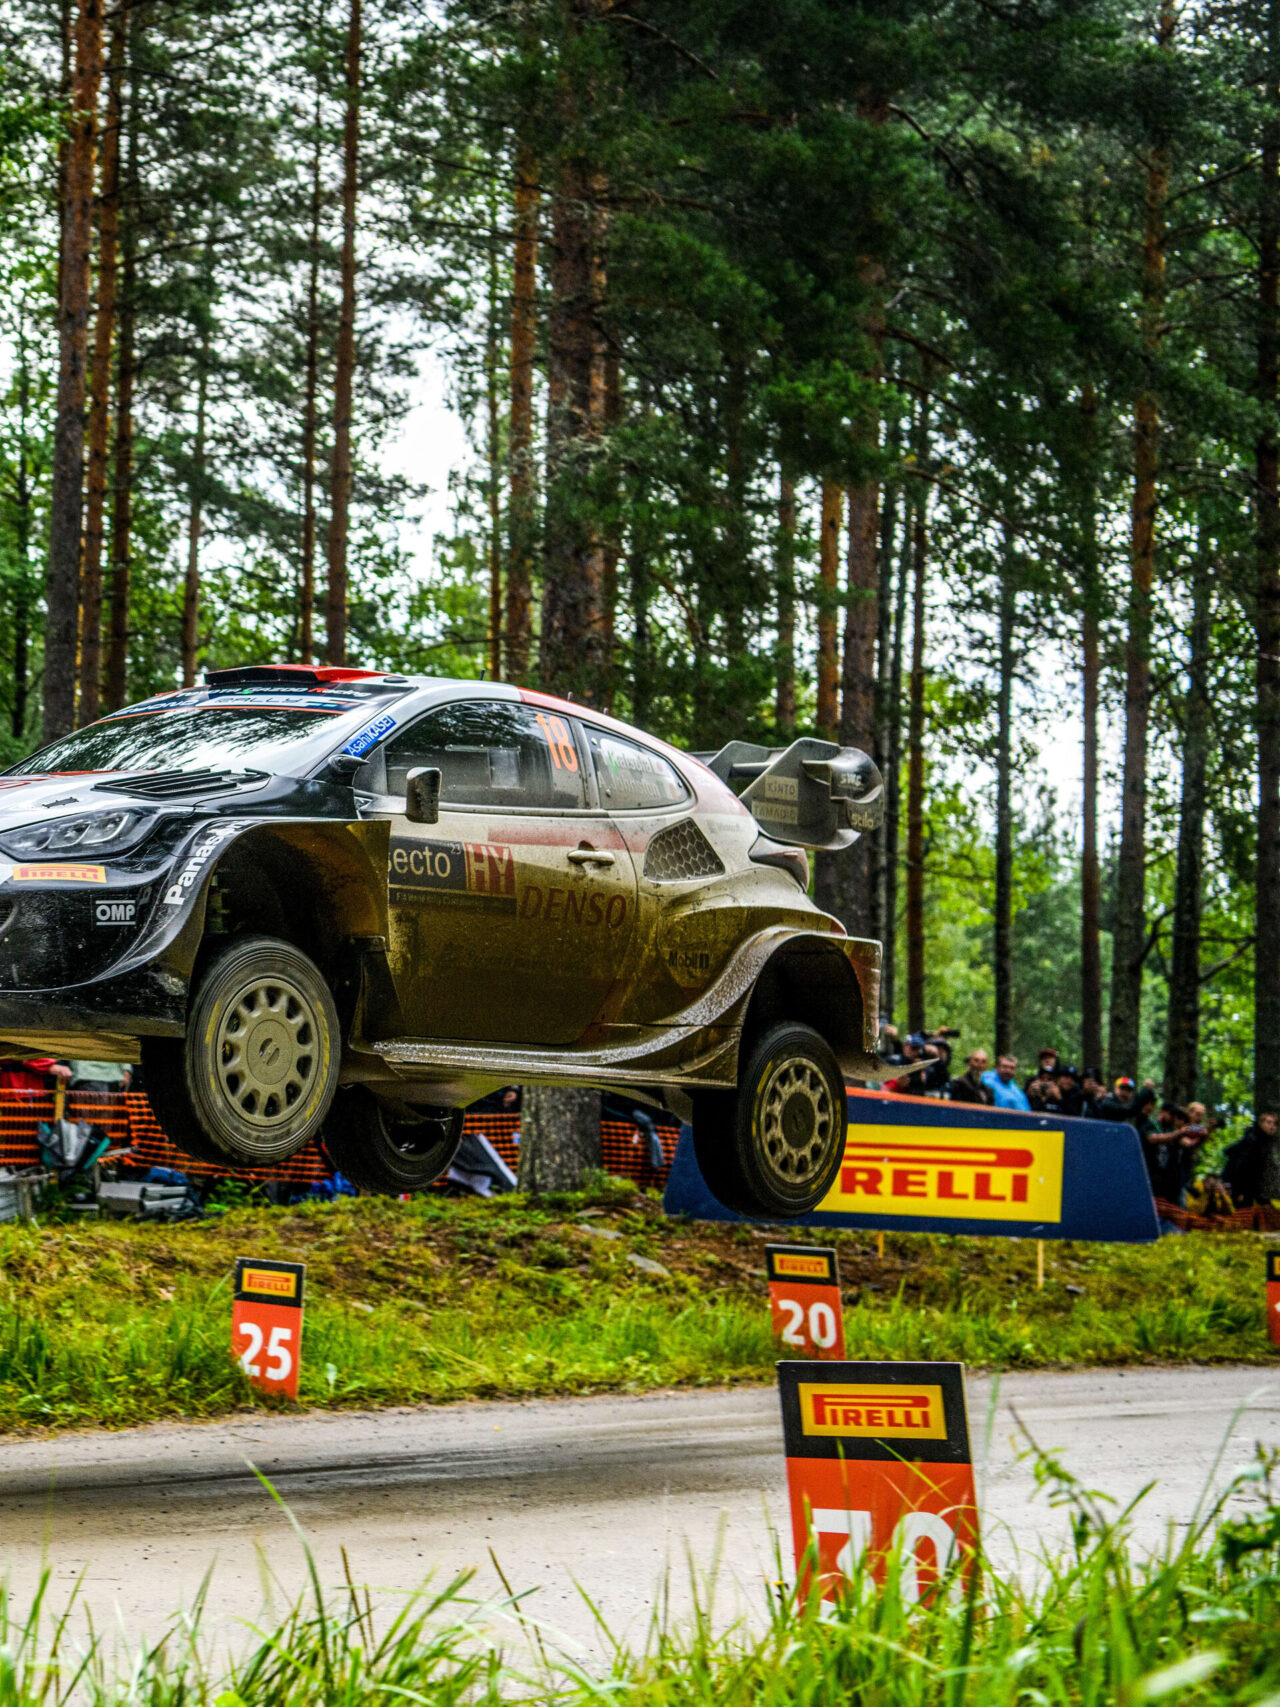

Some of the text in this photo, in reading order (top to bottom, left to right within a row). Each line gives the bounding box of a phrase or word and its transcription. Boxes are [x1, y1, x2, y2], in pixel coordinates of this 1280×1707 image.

[535, 713, 579, 773] 18
[20, 866, 98, 880] PIRELLI
[95, 904, 136, 921] OMP
[519, 885, 627, 929] DENSO
[247, 1273, 291, 1292] PIRELLI
[777, 1299, 837, 1349] 20
[238, 1322, 292, 1381] 25
[812, 1393, 931, 1429] PIRELLI
